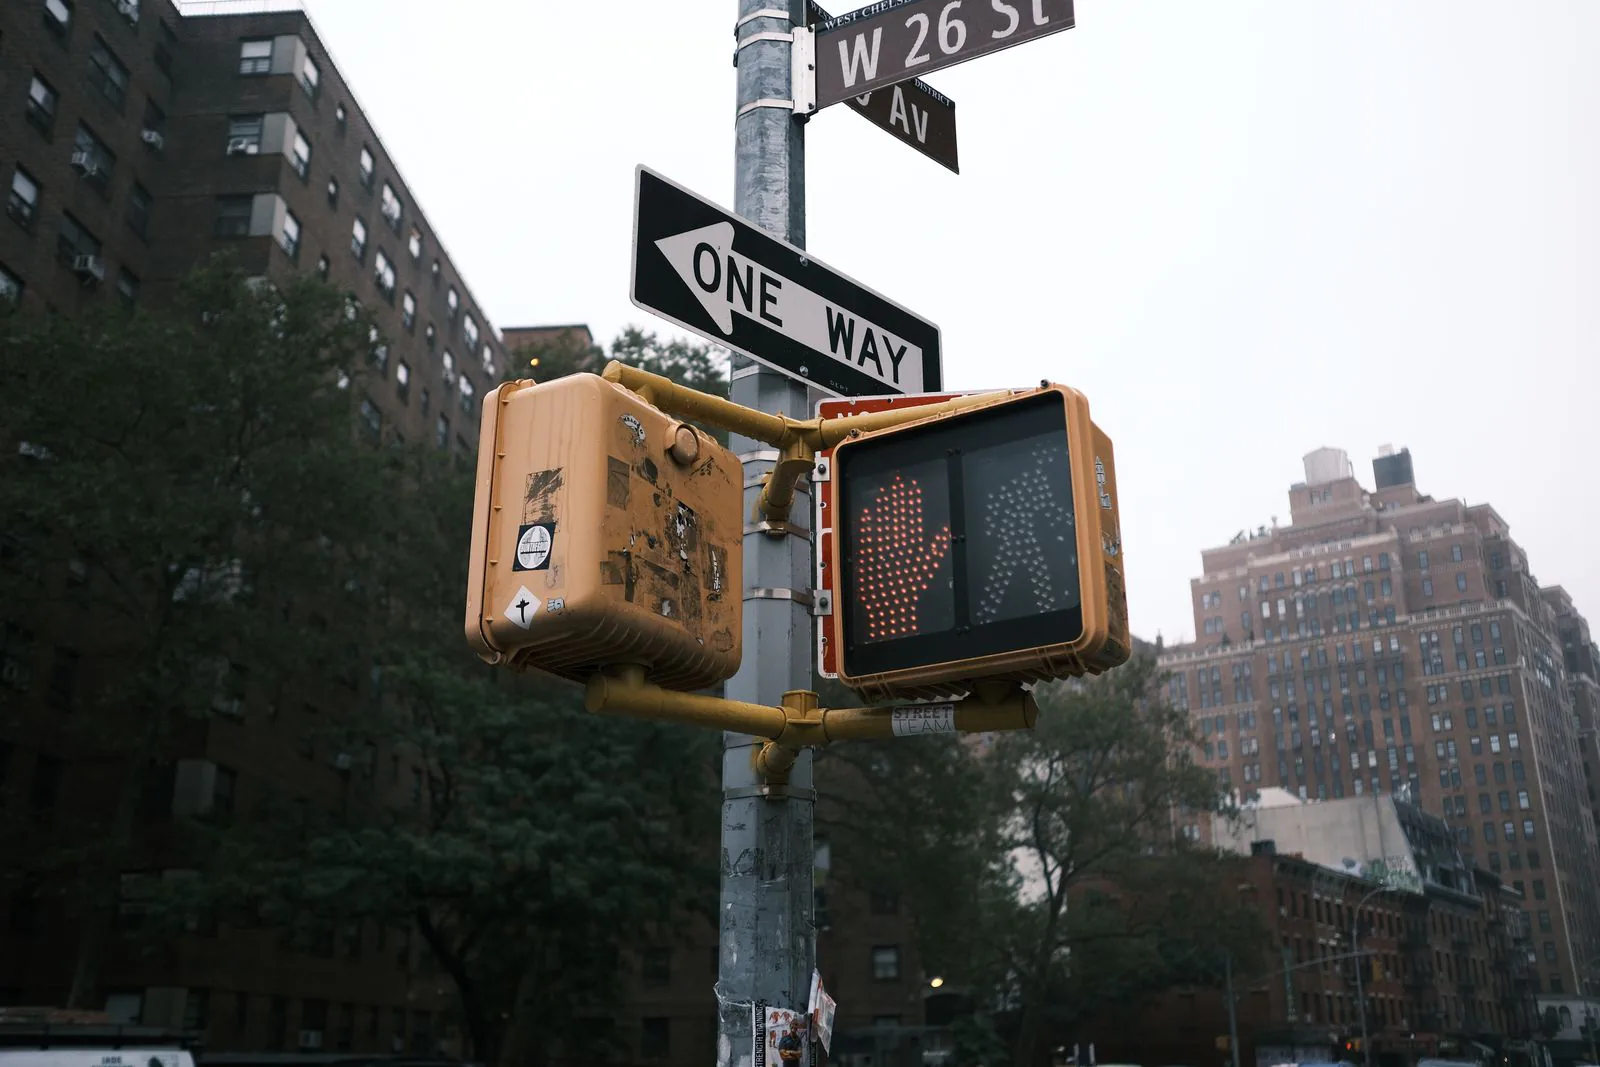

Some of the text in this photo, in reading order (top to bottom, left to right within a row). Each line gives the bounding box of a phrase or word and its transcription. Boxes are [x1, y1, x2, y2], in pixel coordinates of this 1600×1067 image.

[825, 0, 911, 30] WEST CHELS
[838, 27, 882, 88] W
[904, 1, 968, 68] 26
[915, 78, 950, 107] DISTRICT
[889, 85, 928, 144] Av
[693, 242, 907, 384] ONE WAY
[894, 706, 953, 719] STREET
[894, 719, 952, 734] TEAM
[756, 1006, 764, 1036] TRAINING
